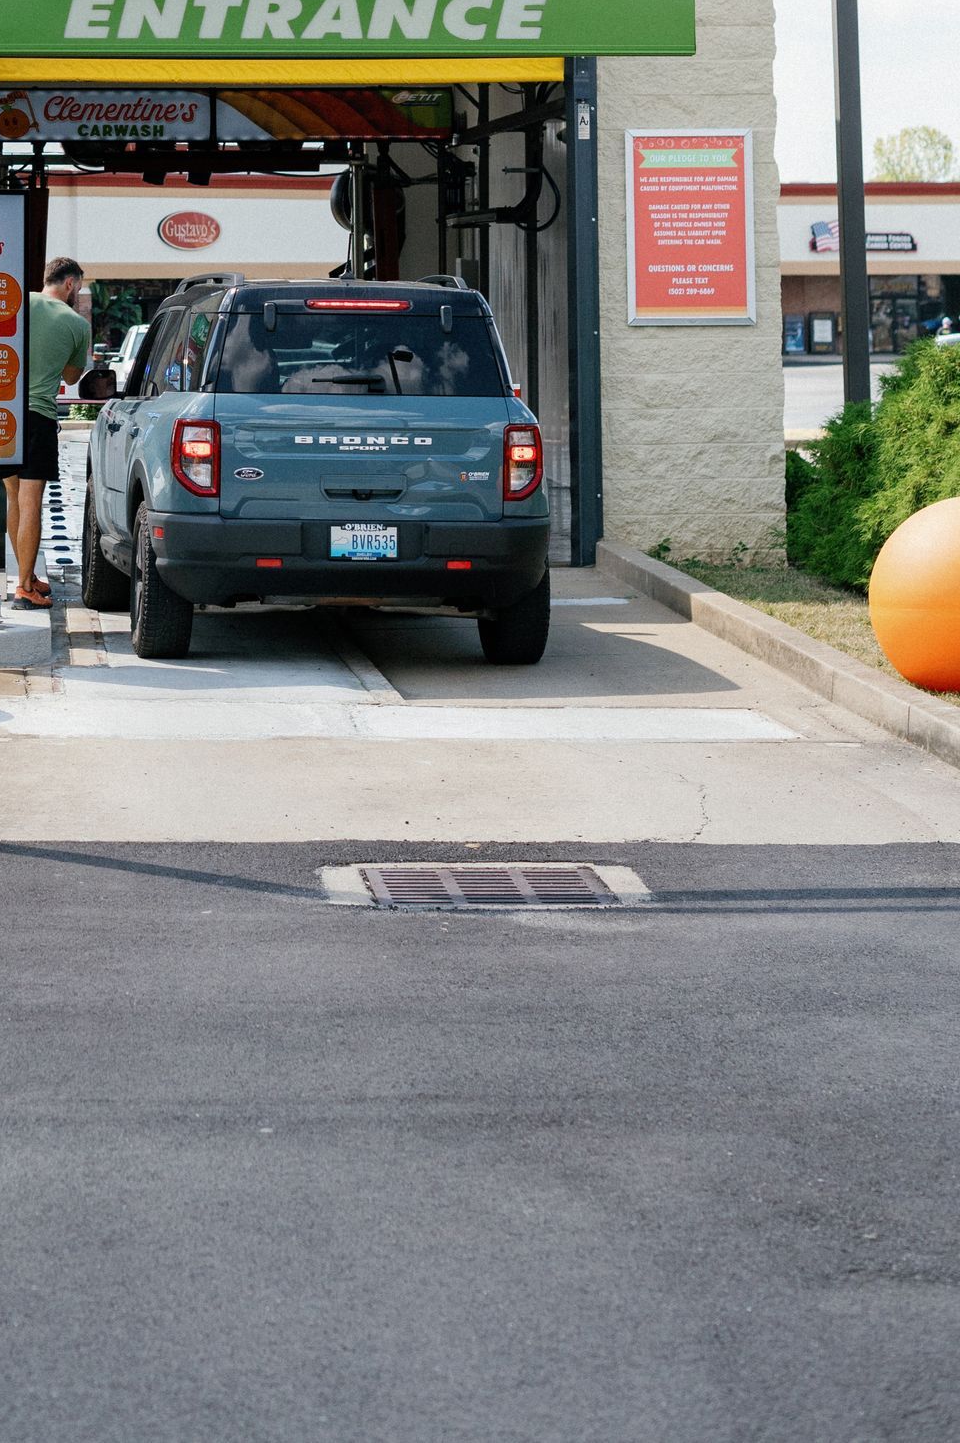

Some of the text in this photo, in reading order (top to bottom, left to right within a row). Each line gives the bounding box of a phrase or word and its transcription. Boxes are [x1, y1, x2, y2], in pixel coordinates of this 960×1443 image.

[392, 91, 443, 104] PETIT
[43, 95, 198, 123] Clementine's
[77, 124, 164, 137] CARWASH
[650, 154, 728, 162] OUR PLEDGE TO YOU
[165, 220, 217, 237] Gustavo's
[294, 436, 432, 445] BRONCO
[352, 534, 396, 550] BVR535
